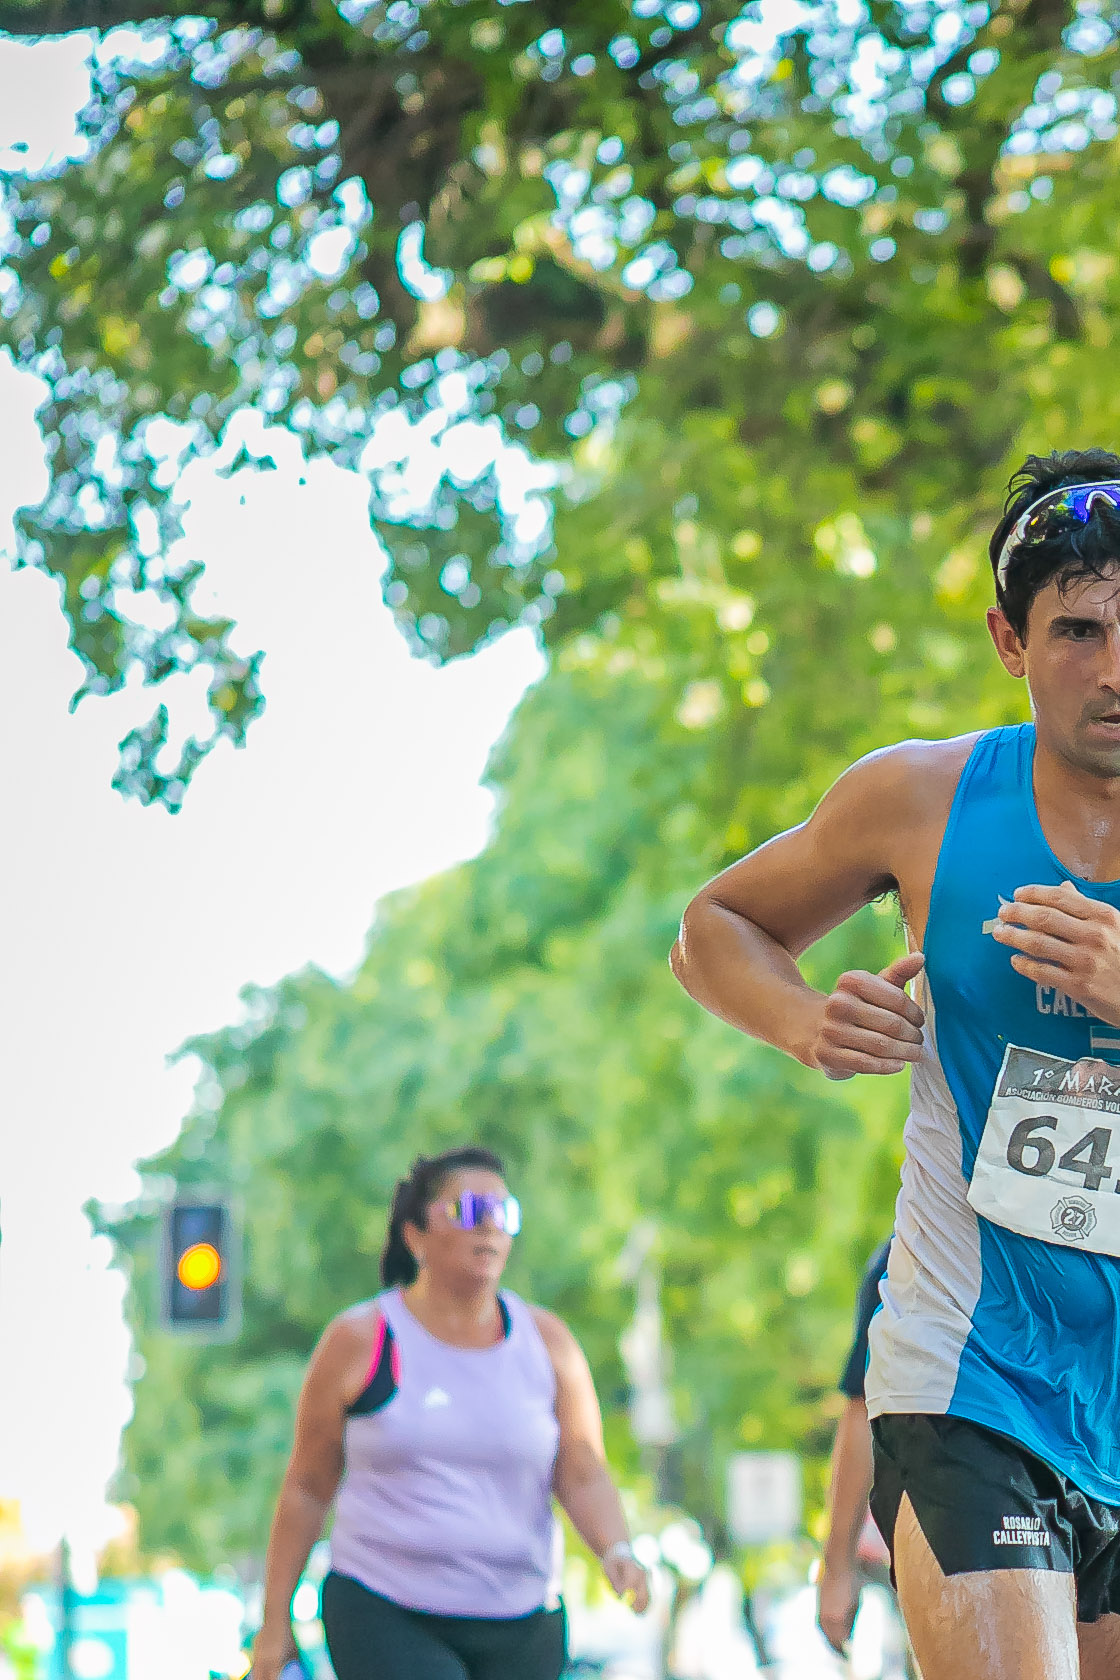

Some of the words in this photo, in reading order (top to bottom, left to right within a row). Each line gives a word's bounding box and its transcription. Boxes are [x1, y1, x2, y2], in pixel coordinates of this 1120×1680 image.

[1056, 1094, 1104, 1110] BOMBEROS
[1063, 1208, 1085, 1226] 27
[1003, 1516, 1041, 1531] ROSARIO
